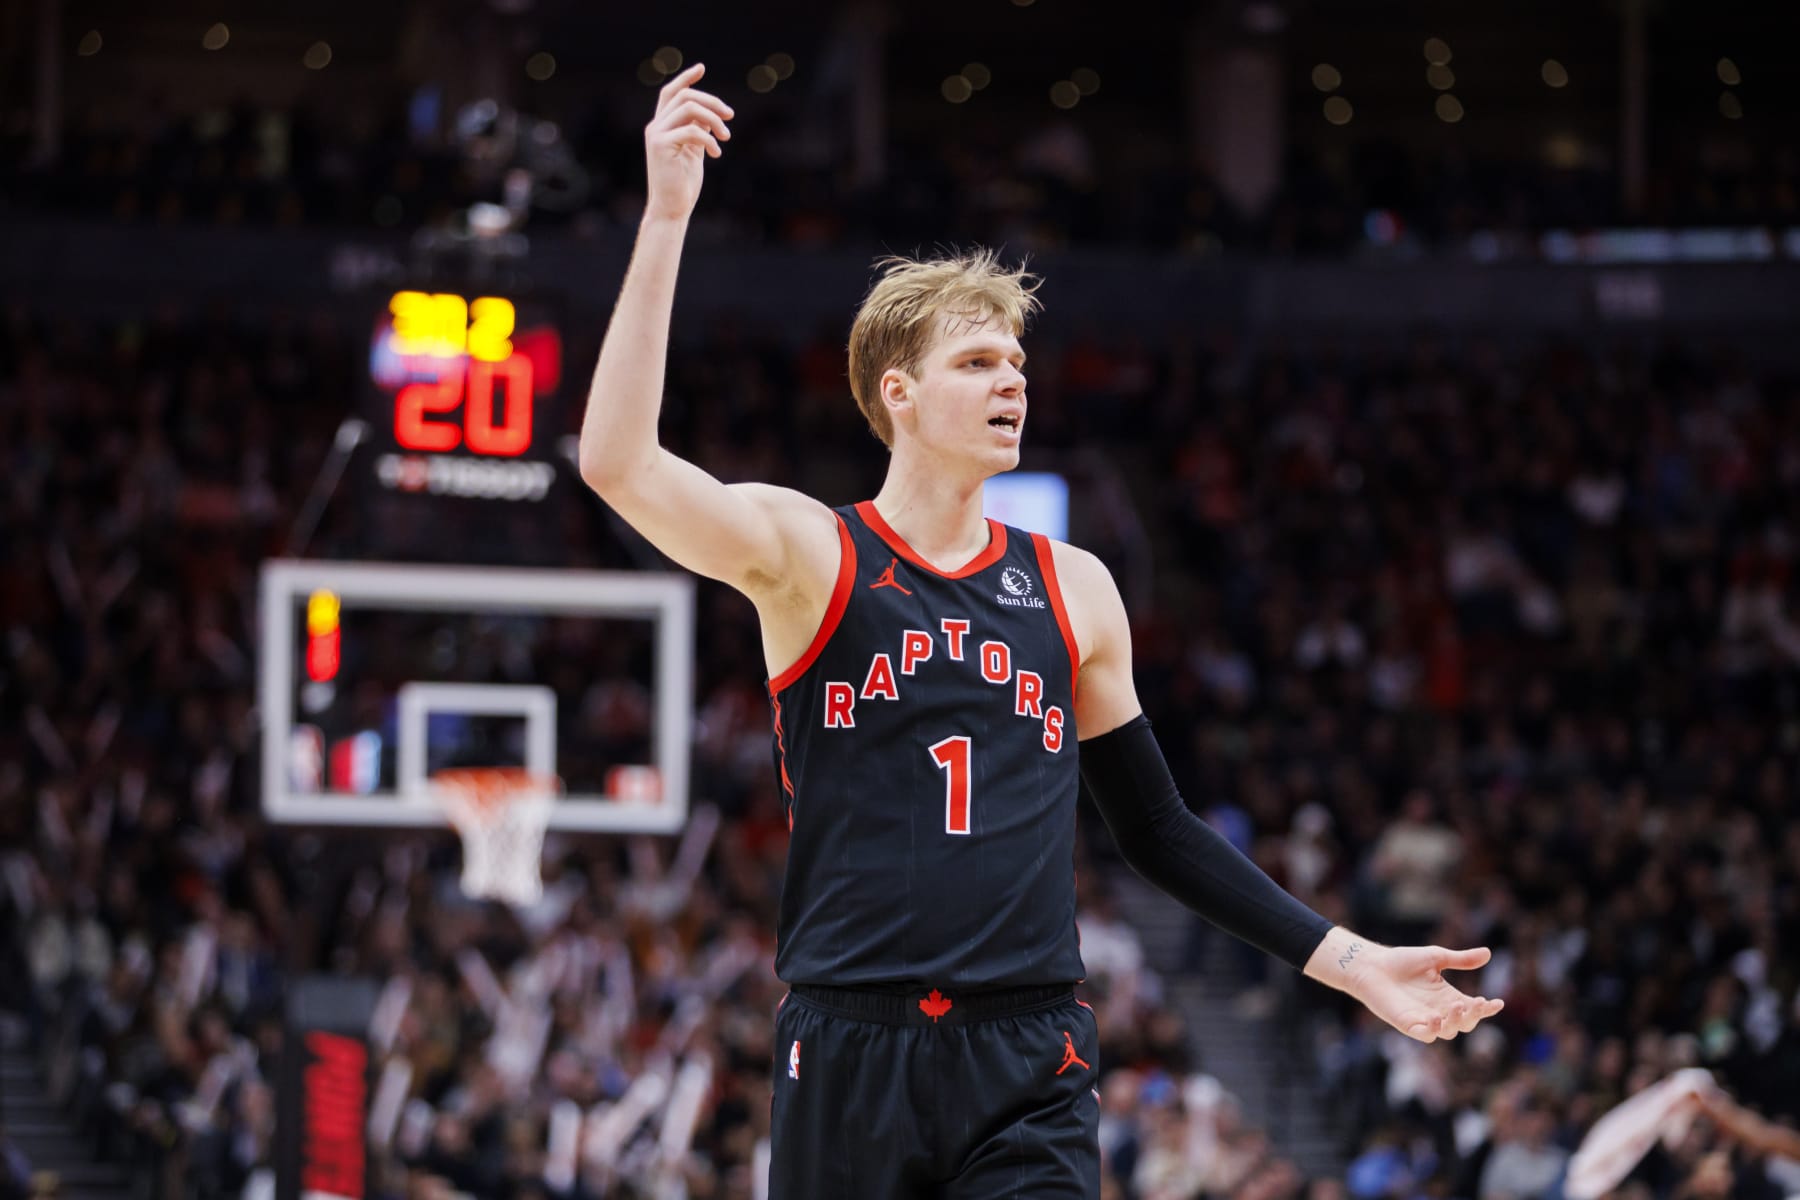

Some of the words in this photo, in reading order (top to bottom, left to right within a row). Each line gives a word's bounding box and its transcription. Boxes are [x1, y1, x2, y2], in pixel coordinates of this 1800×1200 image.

[394, 351, 533, 457] 20
[996, 594, 1021, 606] Sun
[1021, 597, 1046, 609] Life
[824, 618, 1064, 754] RAPTORS
[928, 735, 972, 836] 1
